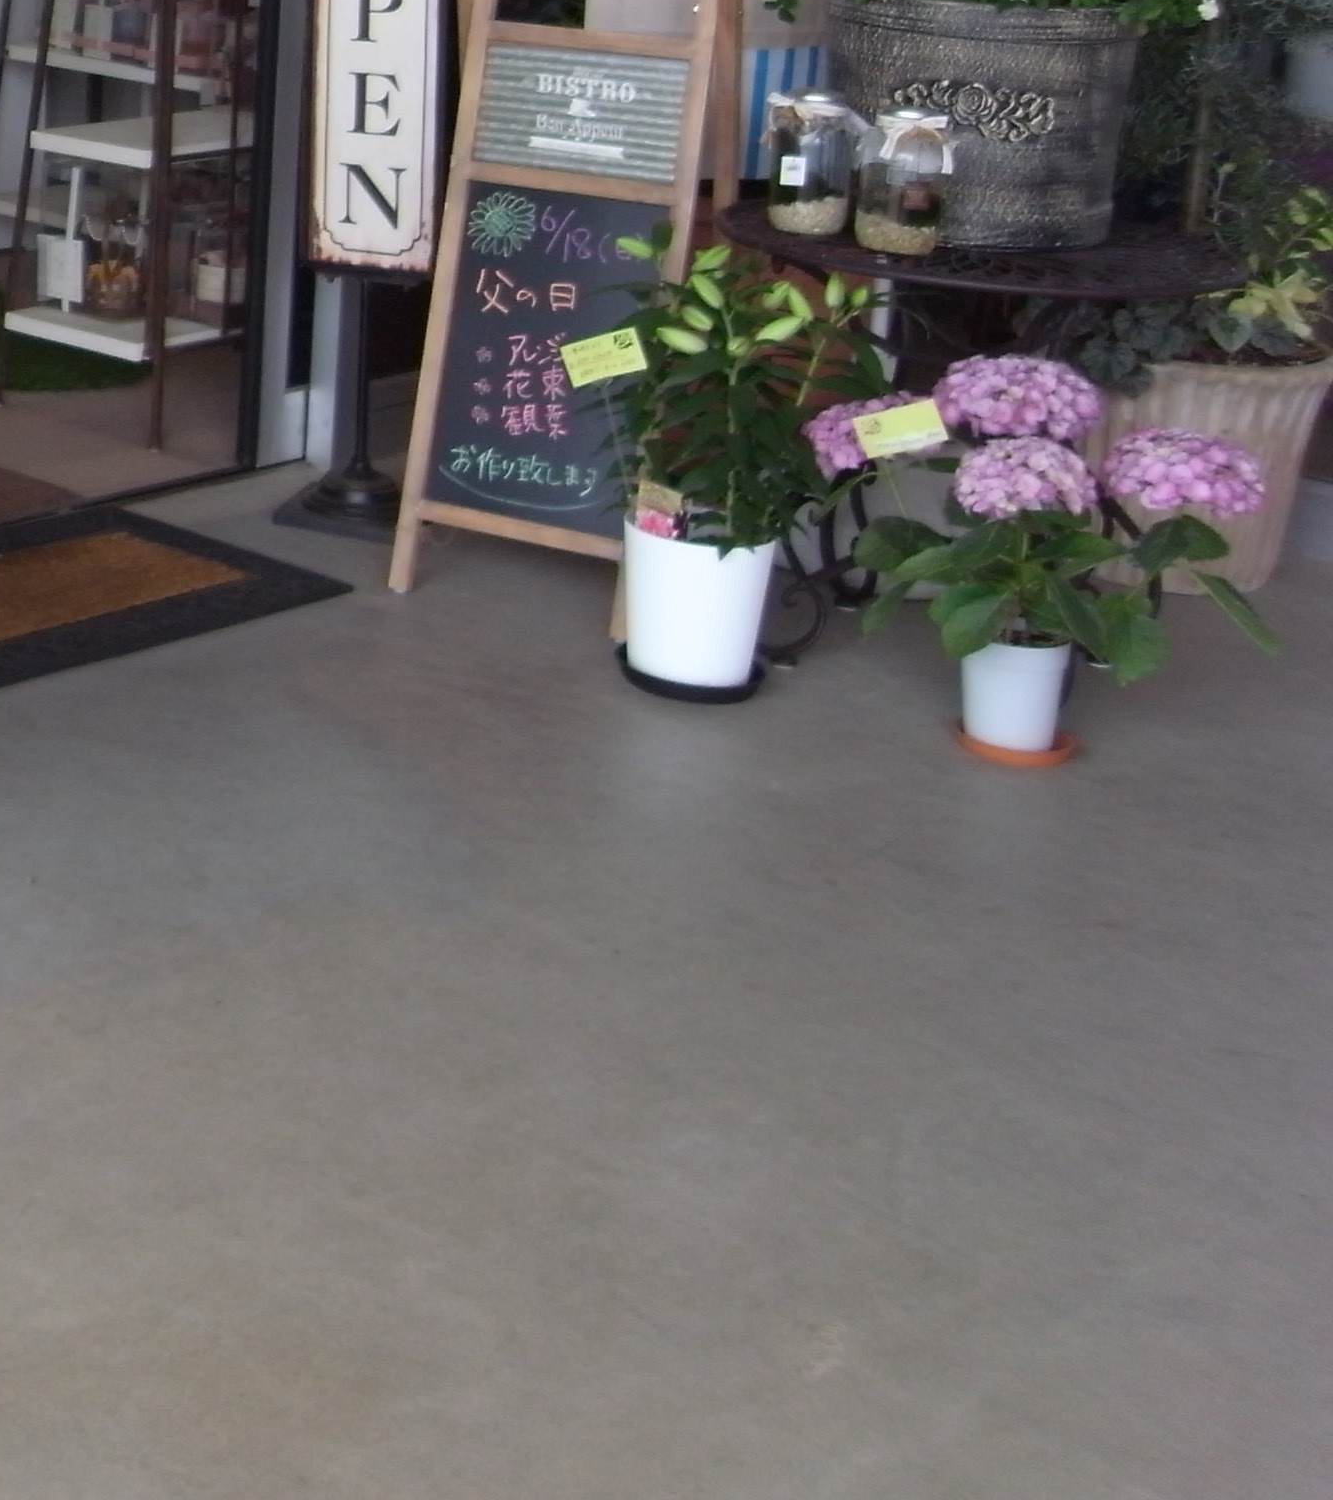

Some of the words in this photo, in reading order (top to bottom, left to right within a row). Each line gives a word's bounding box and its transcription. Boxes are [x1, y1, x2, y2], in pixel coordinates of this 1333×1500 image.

[536, 73, 636, 104] BISTRO
[476, 268, 576, 315] 父の日
[450, 445, 598, 498] お作り致します
